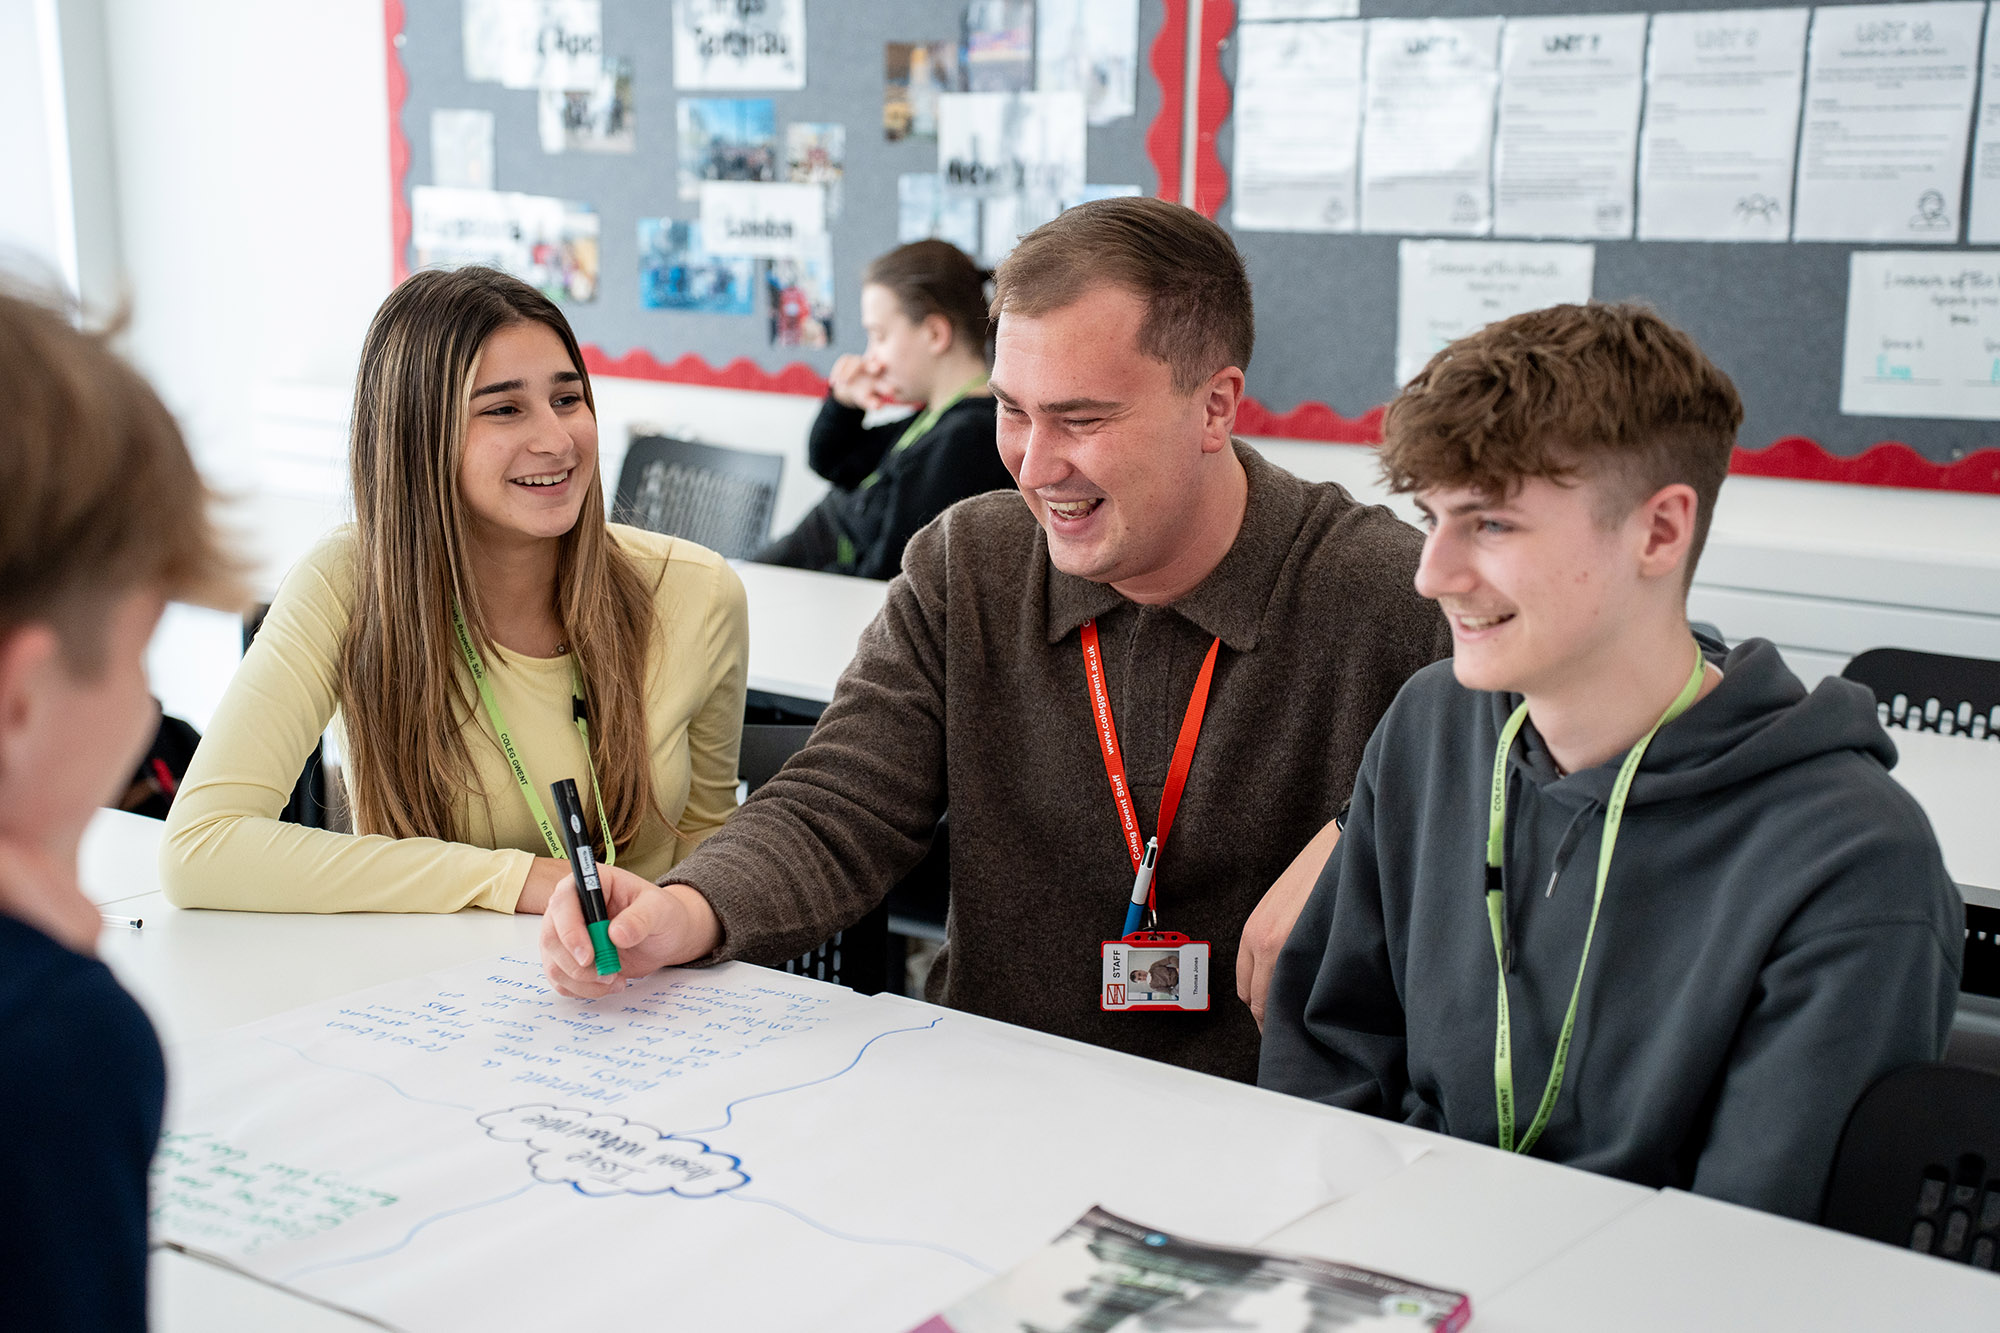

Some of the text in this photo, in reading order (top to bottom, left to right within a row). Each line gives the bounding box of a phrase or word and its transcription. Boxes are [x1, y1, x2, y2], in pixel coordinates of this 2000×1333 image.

[457, 623, 476, 663] Respectful,
[471, 662, 482, 680] Safe
[1087, 644, 1115, 756] www.coleggwent.ac.uk
[500, 732, 529, 787] COLEG GWENT
[1493, 778, 1503, 813] COLEG
[1111, 774, 1142, 861] Coleg Gwent Staff
[540, 819, 560, 854] Yn Barod,
[1112, 949, 1121, 979] STAFF
[487, 975, 552, 997] having
[421, 1001, 467, 1017] This
[577, 1011, 600, 1021] to
[326, 1020, 448, 1052] resolution
[427, 1029, 465, 1041] the
[635, 1036, 665, 1047] be
[493, 1046, 562, 1067] where
[1501, 1088, 1512, 1124] GWENT
[565, 1150, 646, 1188] Issue
